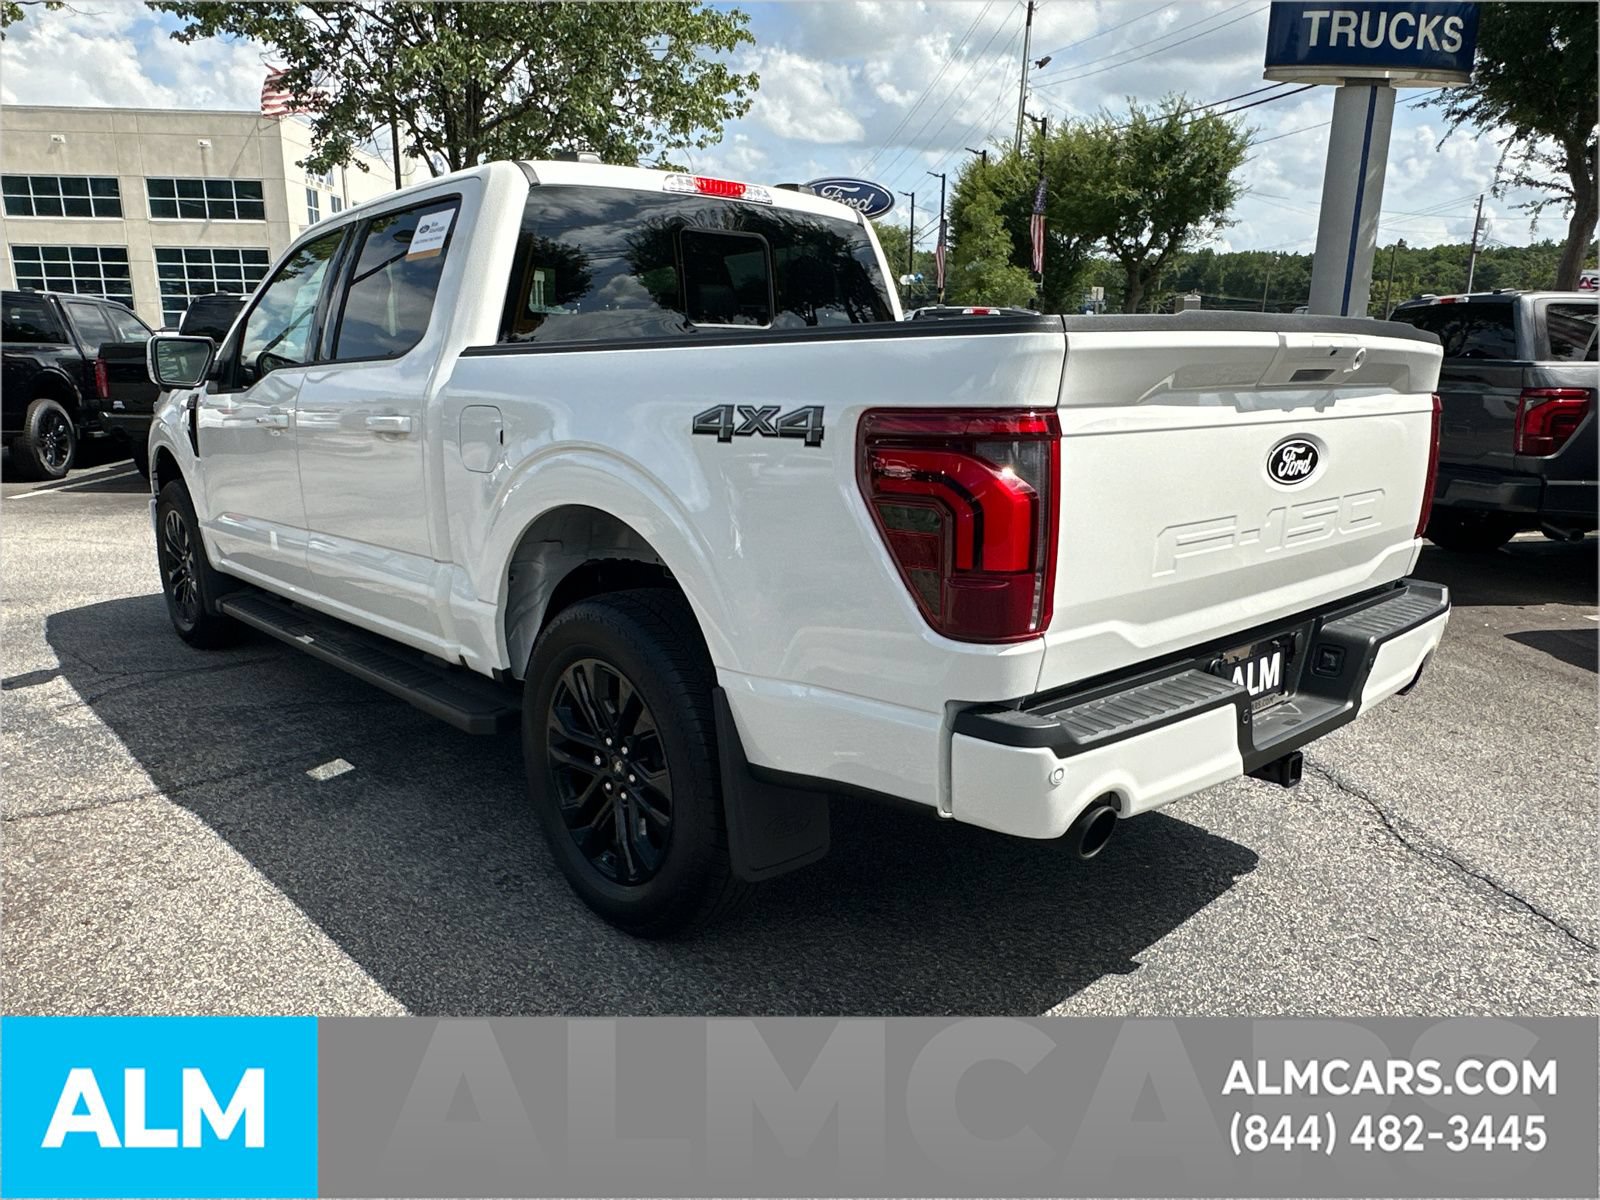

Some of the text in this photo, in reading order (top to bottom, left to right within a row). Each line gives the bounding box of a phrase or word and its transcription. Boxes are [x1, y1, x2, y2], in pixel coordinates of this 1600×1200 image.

[1302, 10, 1464, 53] TRUCKS
[1277, 446, 1313, 477] Ford
[1152, 488, 1386, 578] F-150
[1232, 652, 1281, 697] ALM
